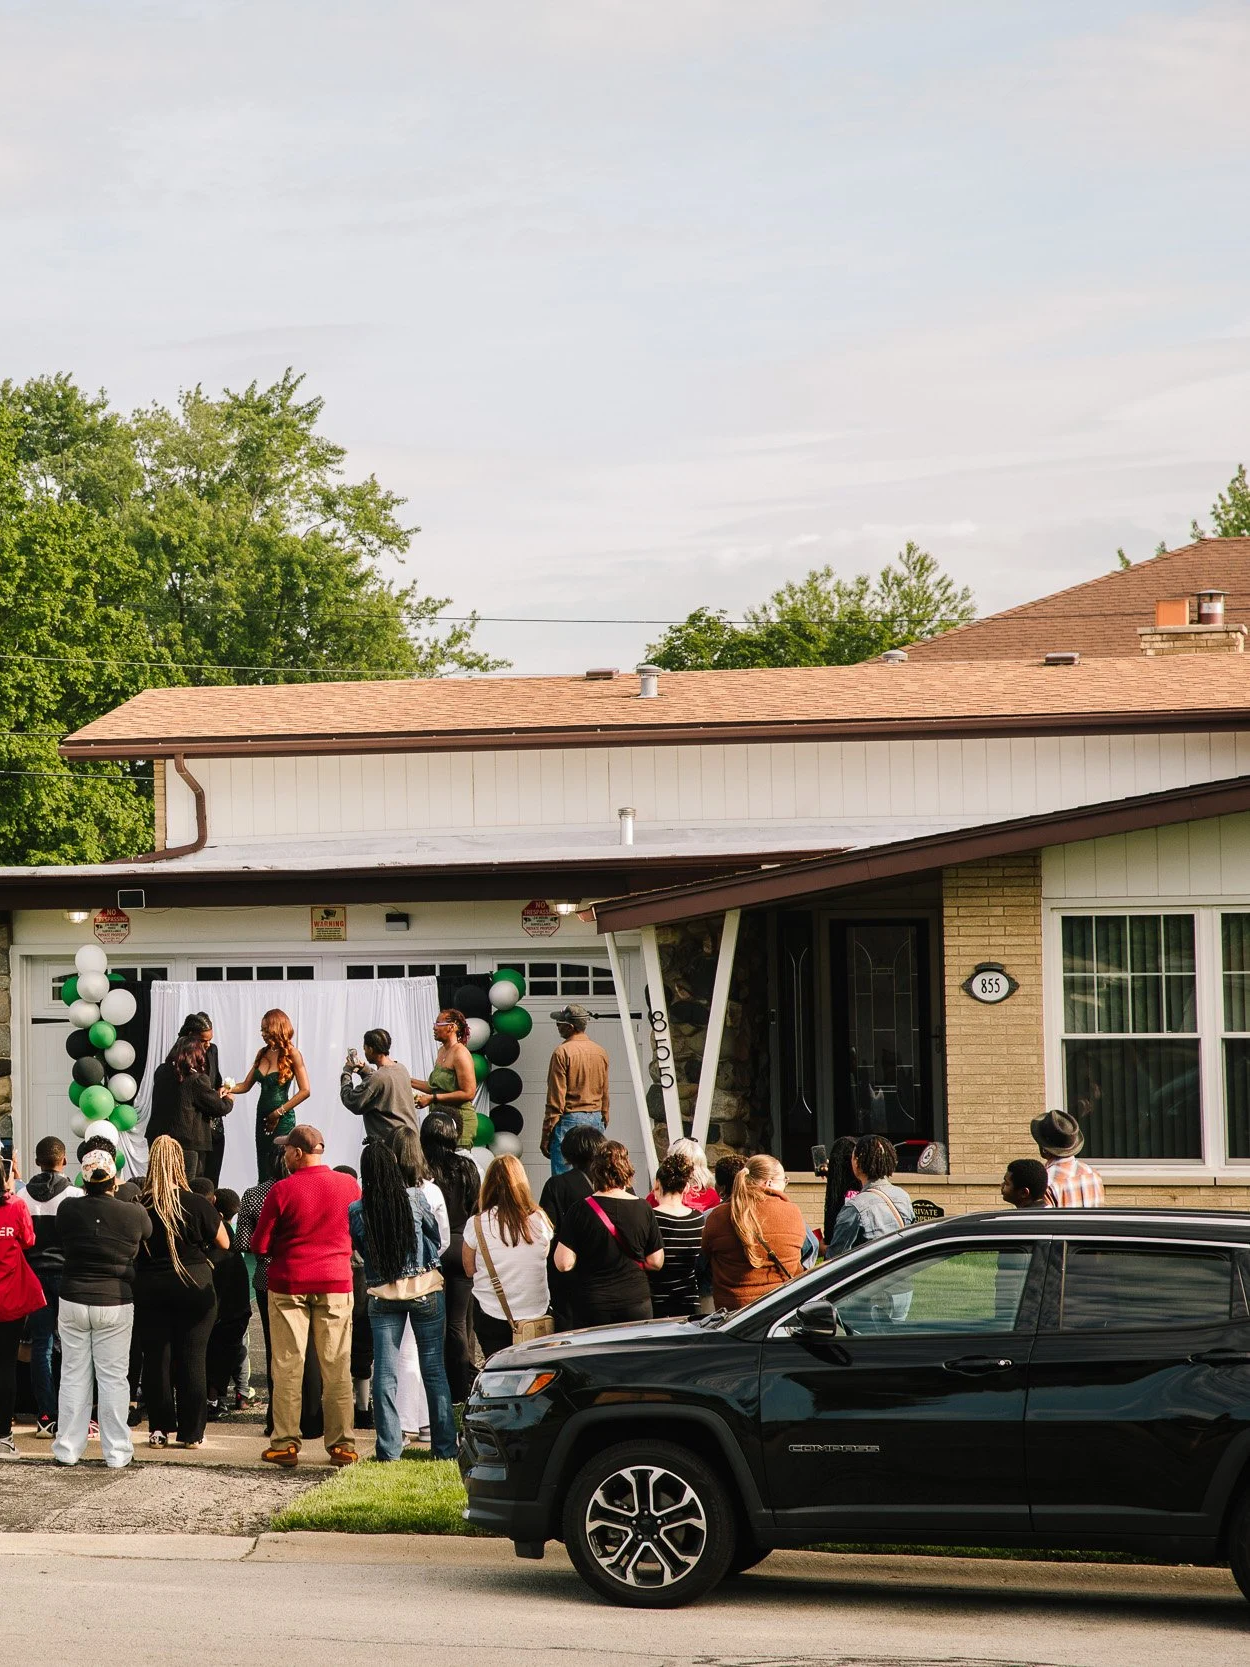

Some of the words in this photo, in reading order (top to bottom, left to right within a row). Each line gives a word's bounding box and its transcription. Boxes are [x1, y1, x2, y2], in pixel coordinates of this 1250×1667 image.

[535, 901, 545, 909] NO
[106, 908, 116, 916] NO
[981, 977, 1000, 994] 855
[652, 1010, 674, 1089] 855
[913, 1208, 938, 1216] RIVATE
[789, 1444, 880, 1452] COMPASS
